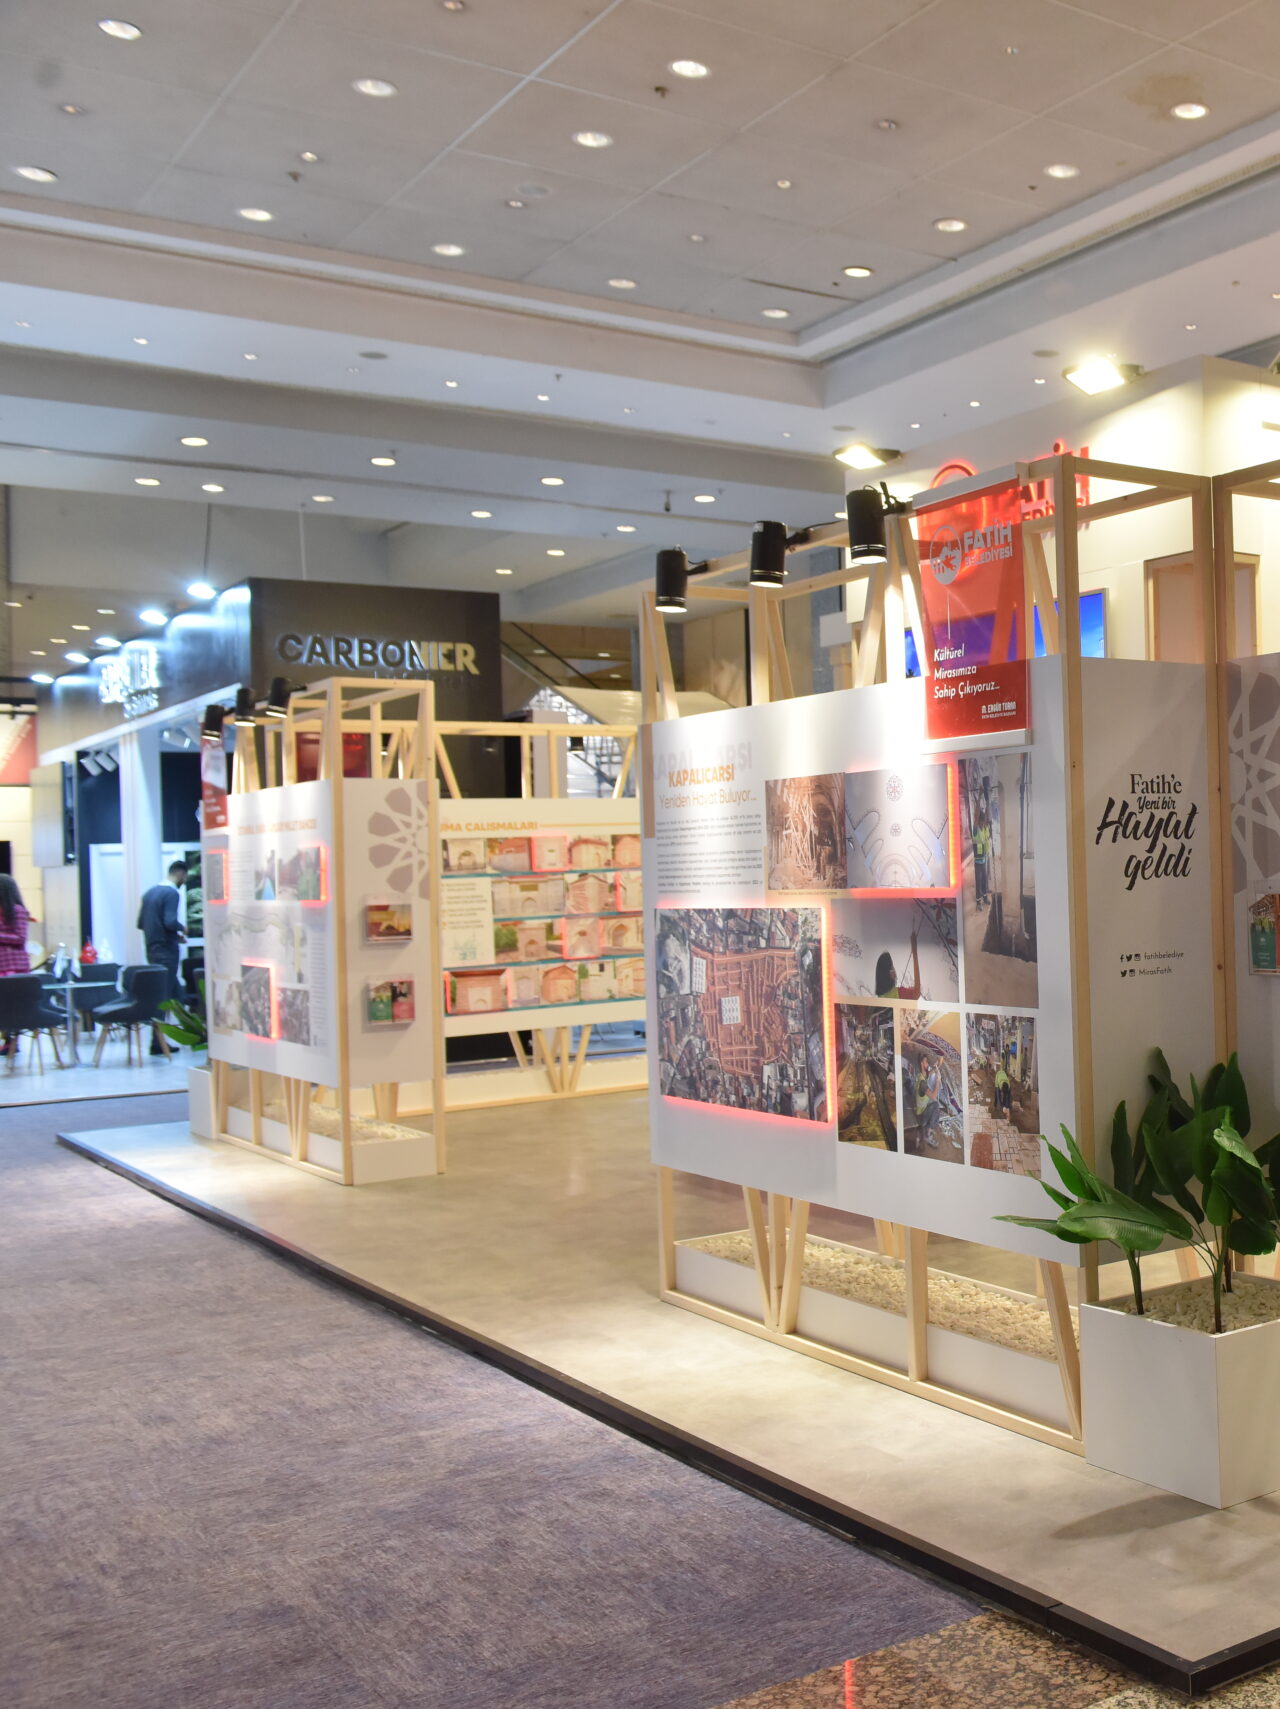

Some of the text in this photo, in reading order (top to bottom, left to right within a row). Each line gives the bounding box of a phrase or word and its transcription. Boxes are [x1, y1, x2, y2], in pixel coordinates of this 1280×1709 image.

[963, 519, 1013, 553] FATİH
[964, 543, 1013, 567] BELEDİYESİ
[277, 633, 480, 675] CARBONIER
[934, 643, 965, 662] Kültürel
[934, 666, 977, 680] Mirasımıza
[933, 684, 956, 699] Sahip
[1136, 796, 1177, 814] Yeni bir
[1096, 797, 1199, 853] Hayat
[1124, 842, 1192, 891] geldi
